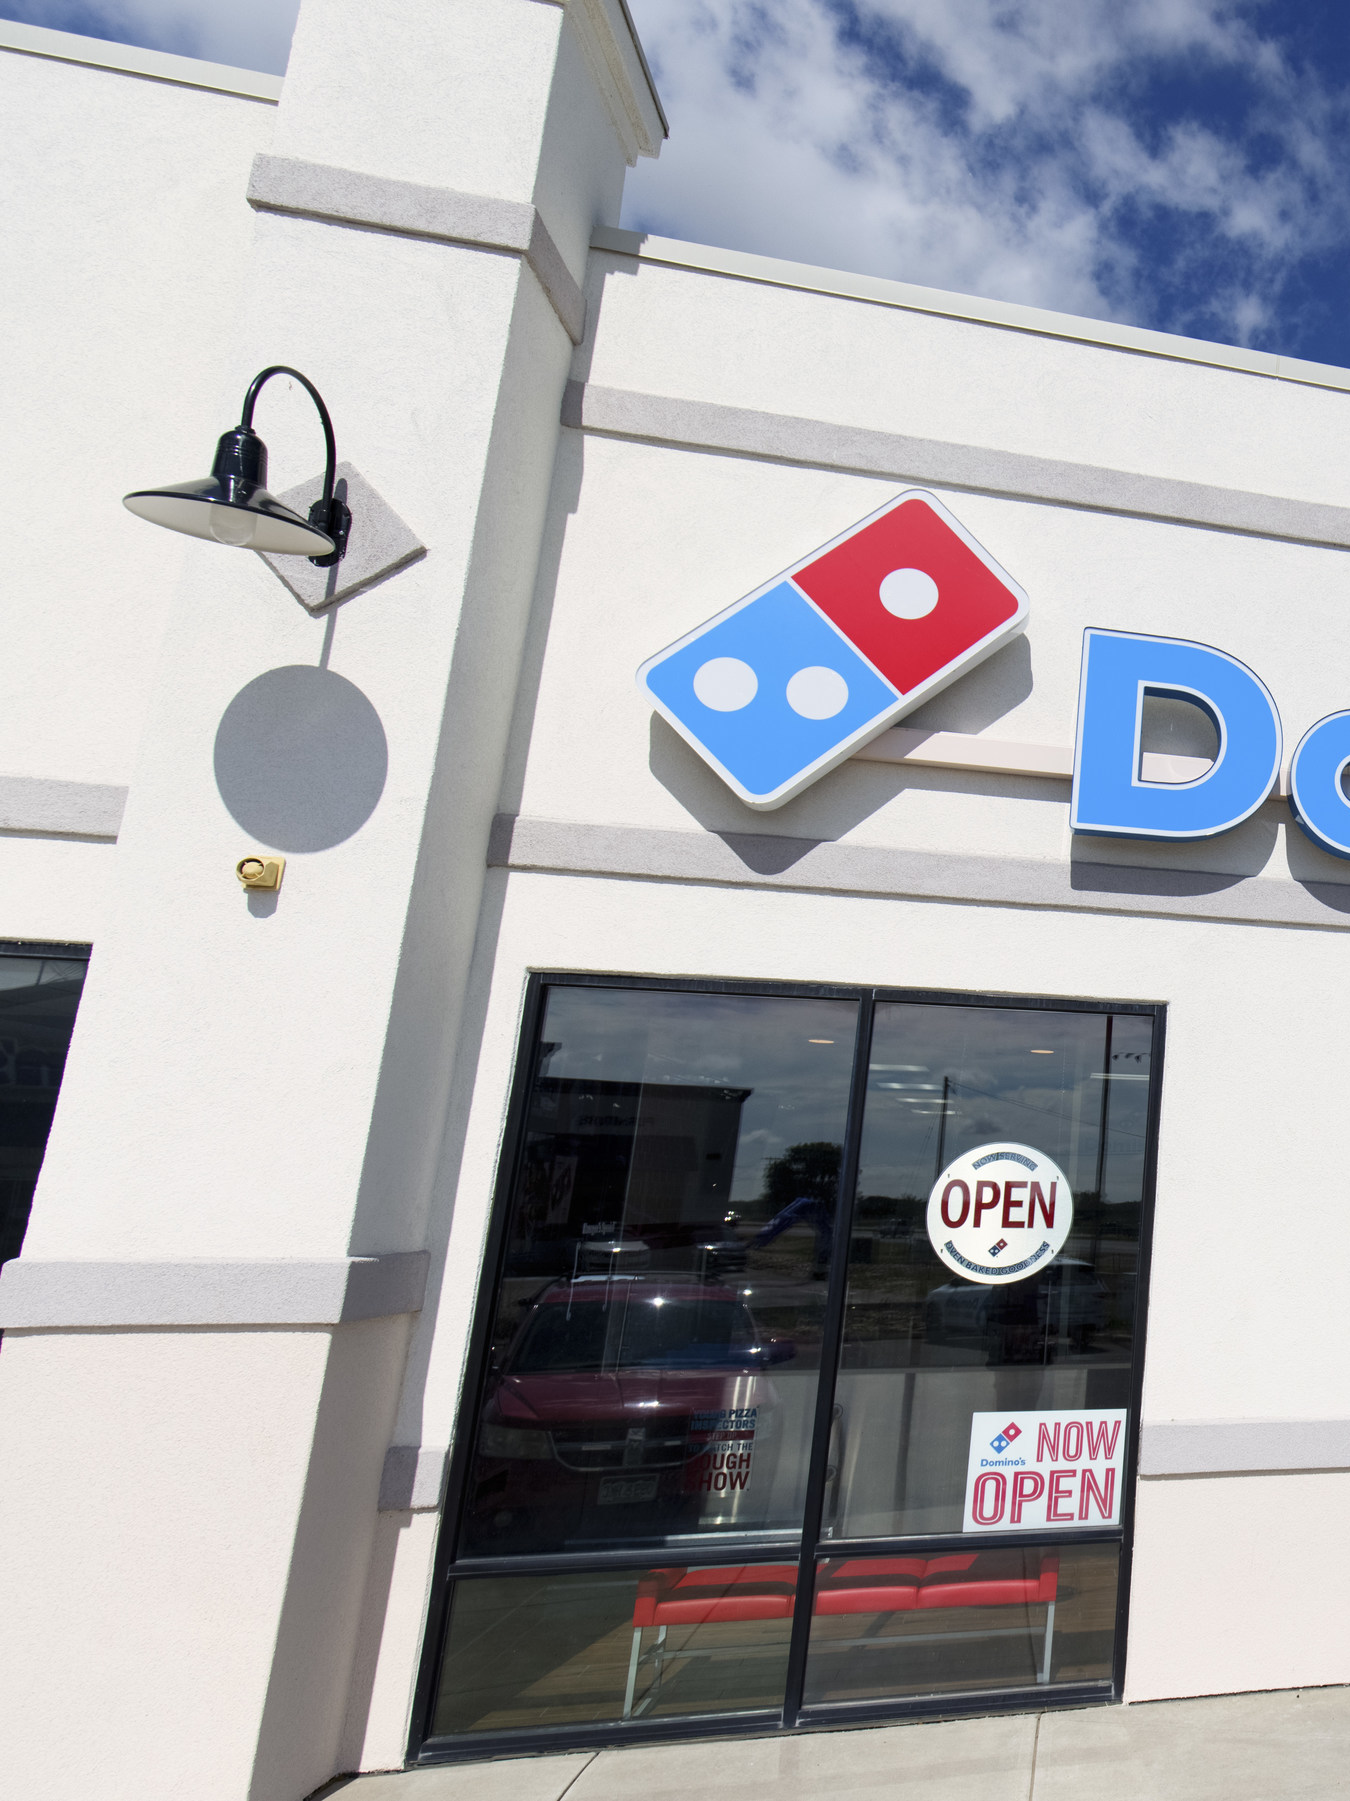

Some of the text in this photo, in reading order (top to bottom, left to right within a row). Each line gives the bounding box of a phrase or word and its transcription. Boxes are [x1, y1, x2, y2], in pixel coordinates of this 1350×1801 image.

[971, 1152, 1039, 1172] NOW SERVING
[941, 1179, 1057, 1229] OPEN
[944, 1240, 1051, 1275] OVEN BAKED GOODNESS
[728, 1408, 758, 1419] PIZZA
[737, 1442, 753, 1451] THE
[1036, 1420, 1122, 1463] NOW
[688, 1453, 751, 1471] OUGH
[980, 1457, 1026, 1467] Domino's
[972, 1468, 1116, 1526] OPEN
